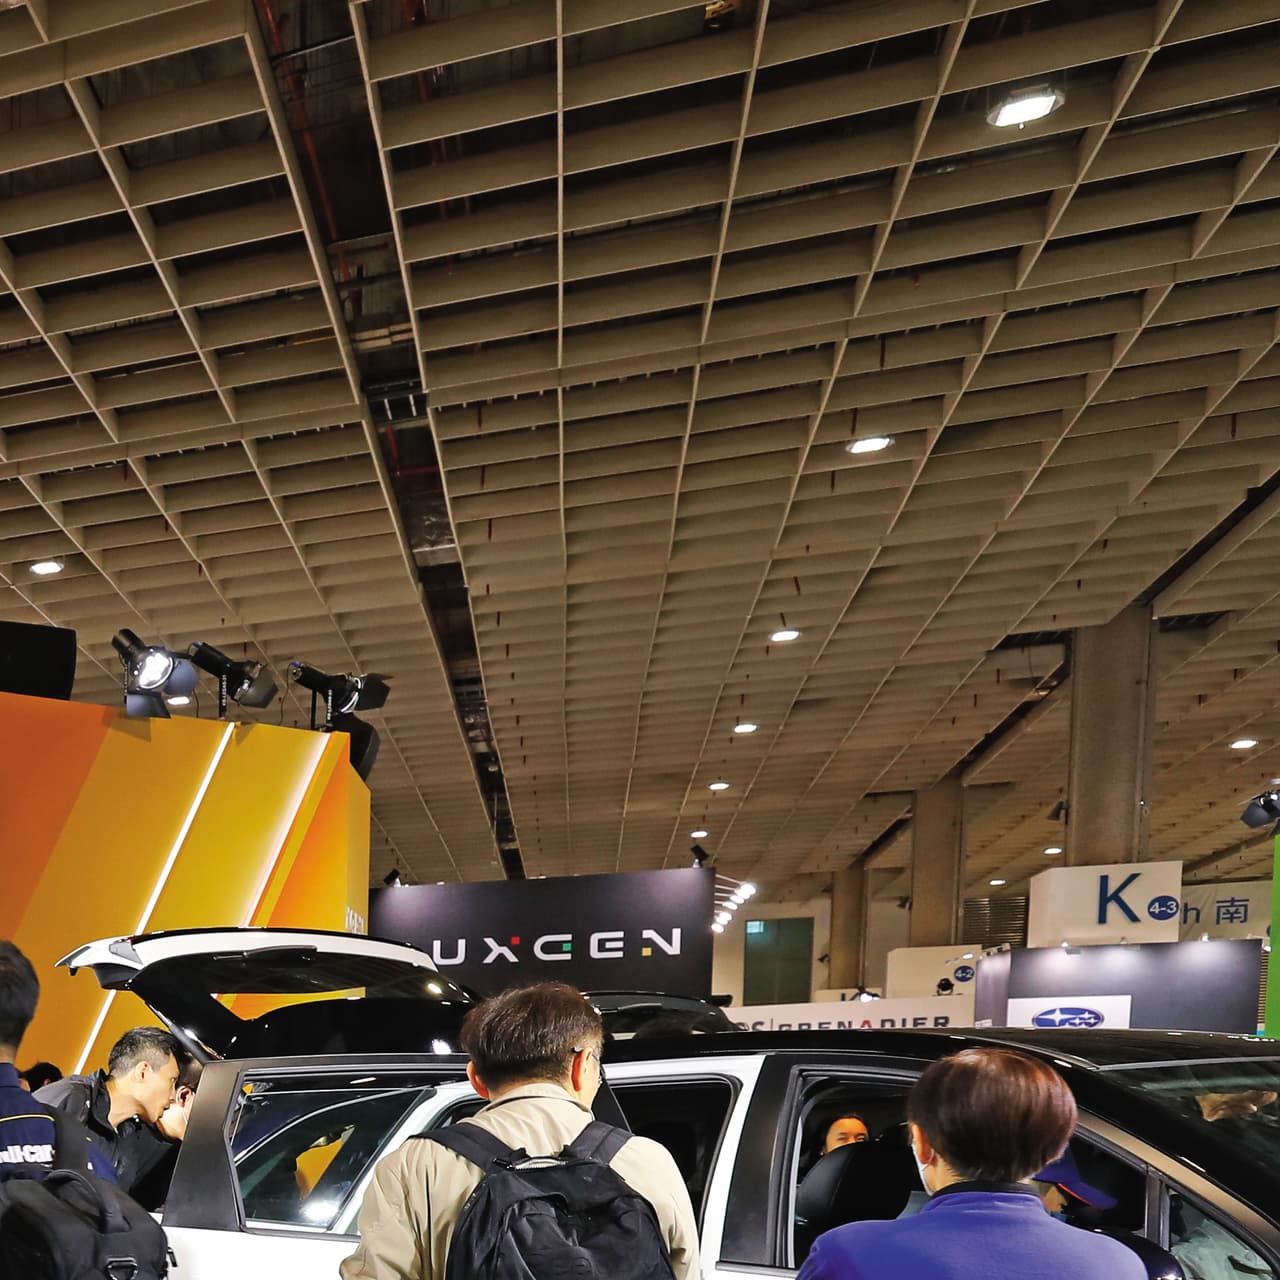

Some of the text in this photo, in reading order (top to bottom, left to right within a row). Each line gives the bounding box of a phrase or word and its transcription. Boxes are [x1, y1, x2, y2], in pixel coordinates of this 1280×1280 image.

[1096, 872, 1143, 925] K
[1148, 901, 1178, 915] 4-3
[1215, 896, 1251, 926] 南
[432, 927, 682, 966] UXGEN
